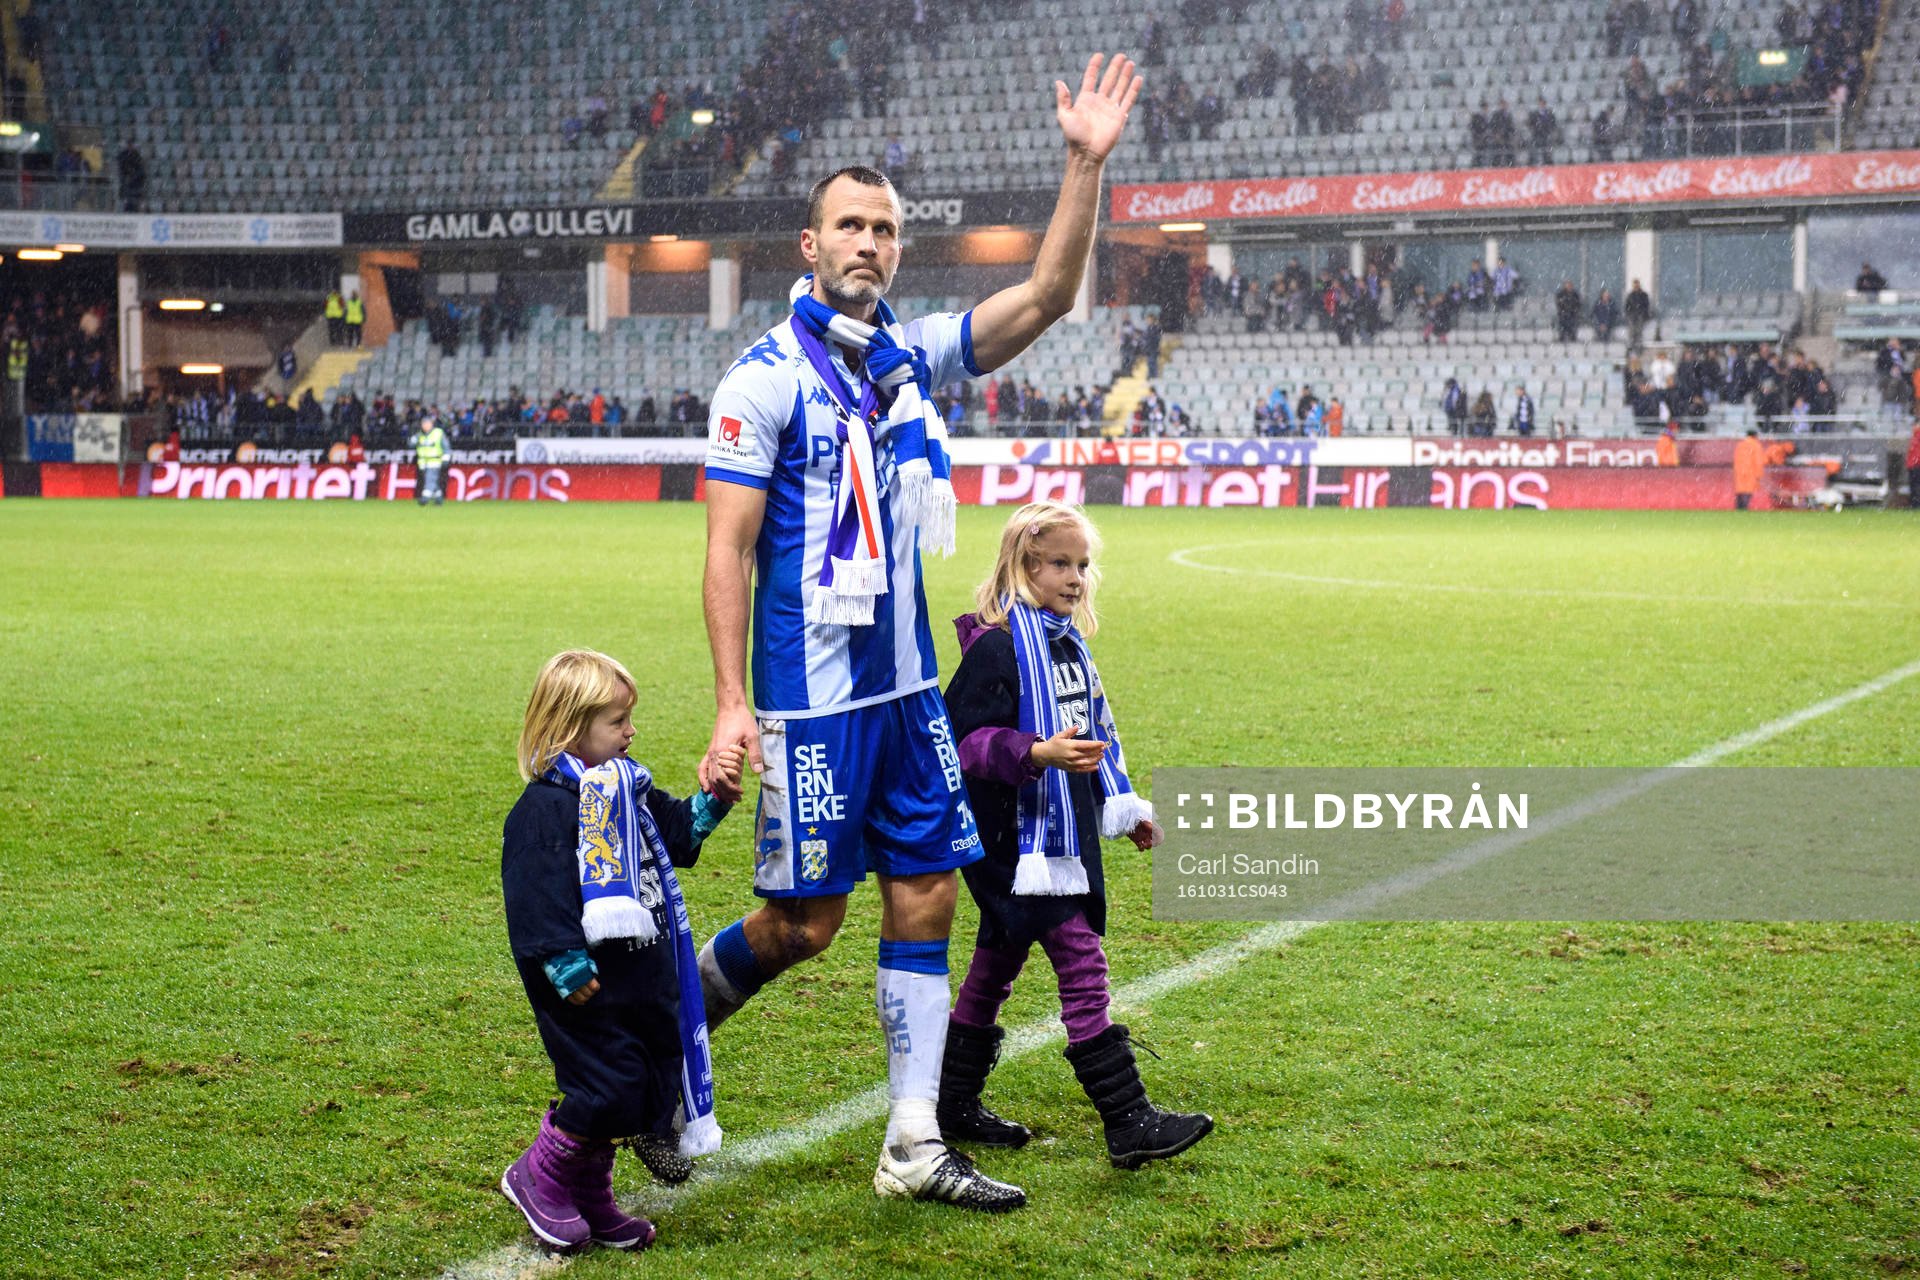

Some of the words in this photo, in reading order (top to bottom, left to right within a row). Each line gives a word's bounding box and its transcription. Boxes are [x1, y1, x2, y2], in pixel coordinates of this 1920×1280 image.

[1352, 174, 1445, 210] Estrella
[1461, 171, 1554, 207] Estrella
[1593, 163, 1692, 200] Estrella
[1709, 159, 1813, 195] Estrella
[899, 197, 962, 225] borg
[1127, 184, 1214, 218] Estrella
[1228, 180, 1318, 214] Estrella
[406, 212, 507, 240] GAMLA
[534, 208, 633, 236] ULLEVI
[1414, 439, 1559, 466] Prioritet
[1566, 440, 1659, 467] Finan
[138, 460, 376, 499] Prioritet
[980, 464, 1291, 508] Priritet
[794, 744, 828, 771] SE
[796, 769, 834, 797] RN
[882, 988, 912, 1054] SKF
